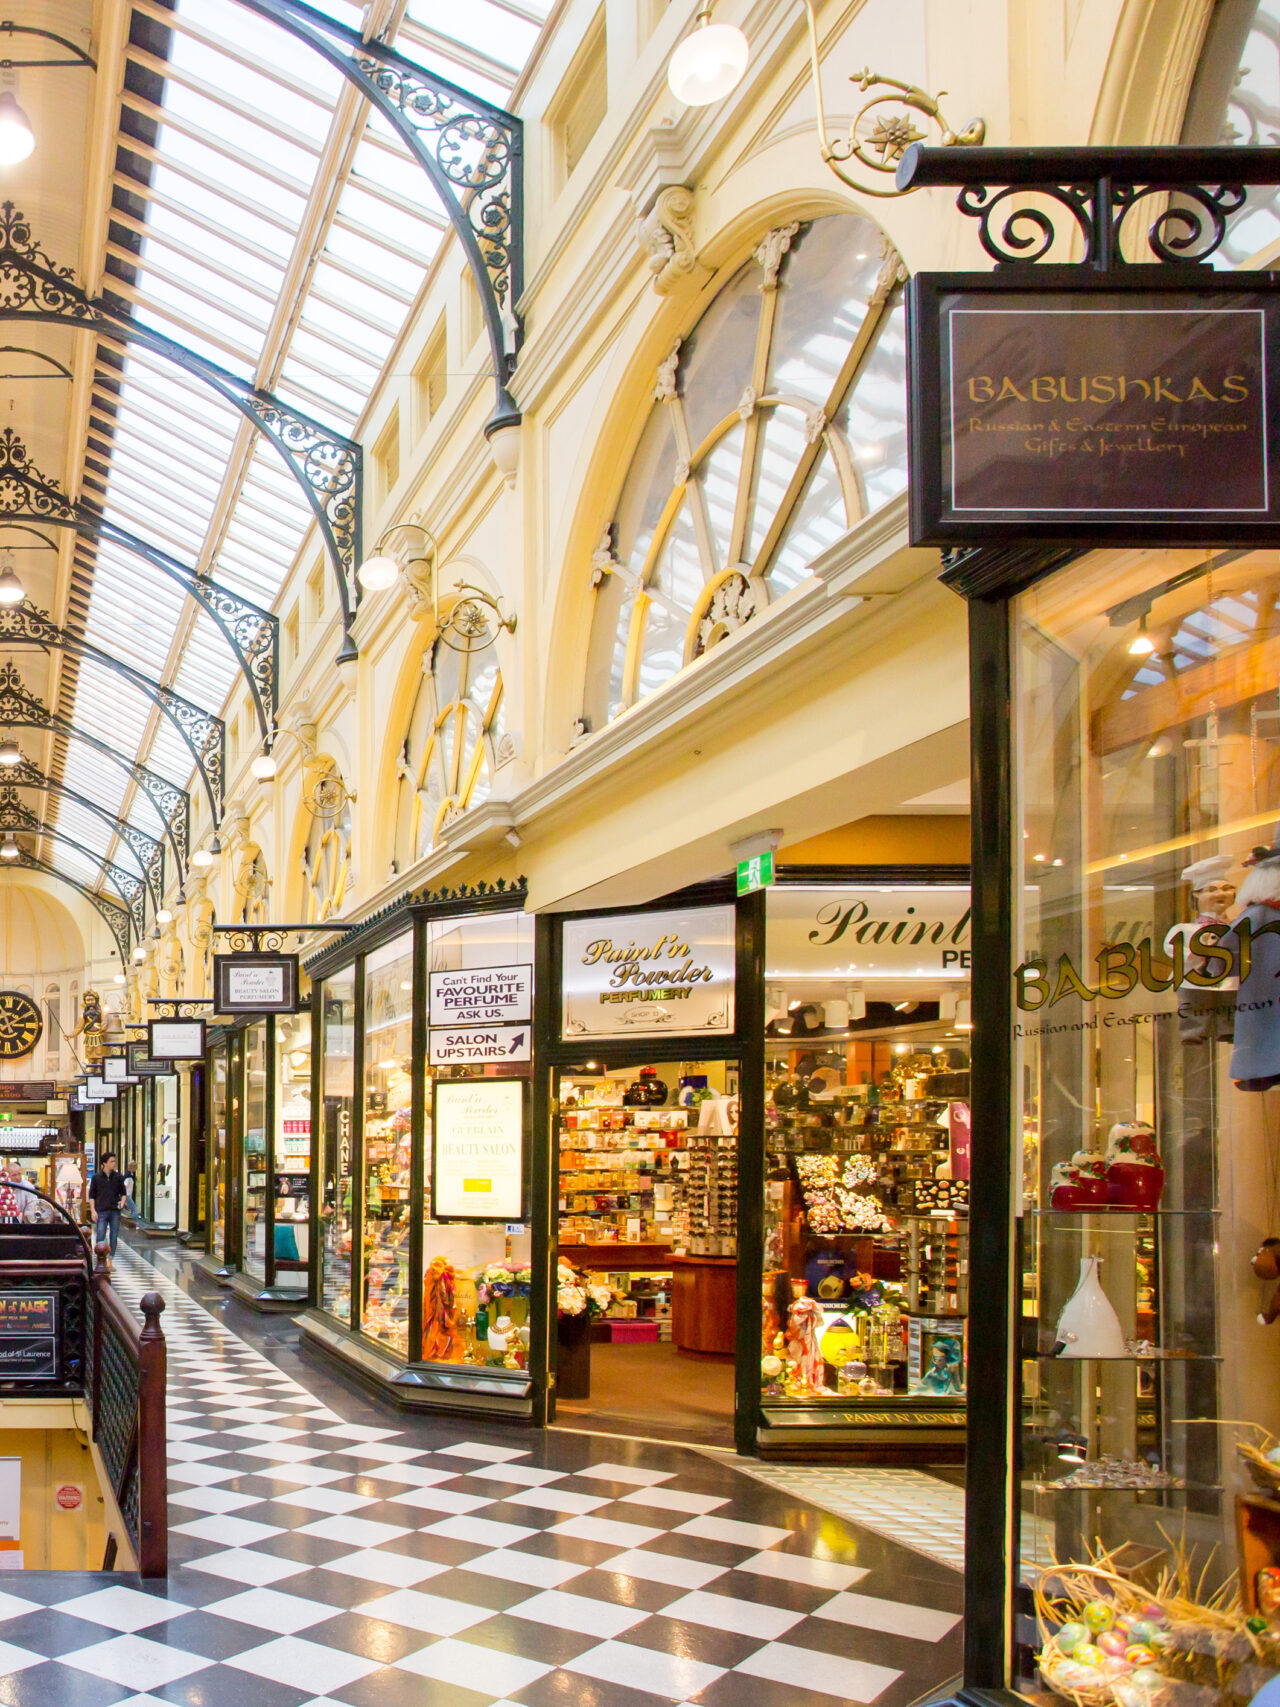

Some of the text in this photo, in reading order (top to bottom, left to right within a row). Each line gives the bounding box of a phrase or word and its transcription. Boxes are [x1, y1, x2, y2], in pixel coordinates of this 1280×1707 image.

[968, 375, 1249, 403] BABUSHKAS
[969, 417, 1248, 438] Russian & Eastern European
[1024, 438, 1189, 458] Gifts & Jewellery
[581, 933, 691, 966] Paint'n
[443, 973, 518, 986] Can't Find Your
[609, 959, 714, 988] Powder
[436, 982, 525, 998] FAVOURITE
[599, 986, 693, 1004] PERFUMERY
[444, 993, 518, 1007] PERFUME
[457, 1008, 504, 1019] ASK US.
[1013, 1000, 1273, 1040] Russian and Eastern European
[446, 1033, 497, 1046] SALON
[436, 1045, 507, 1058] UPSTAIRS
[339, 1110, 351, 1176] CHANE
[19, 1300, 49, 1313] MAGIC
[842, 1409, 891, 1423] PAINT
